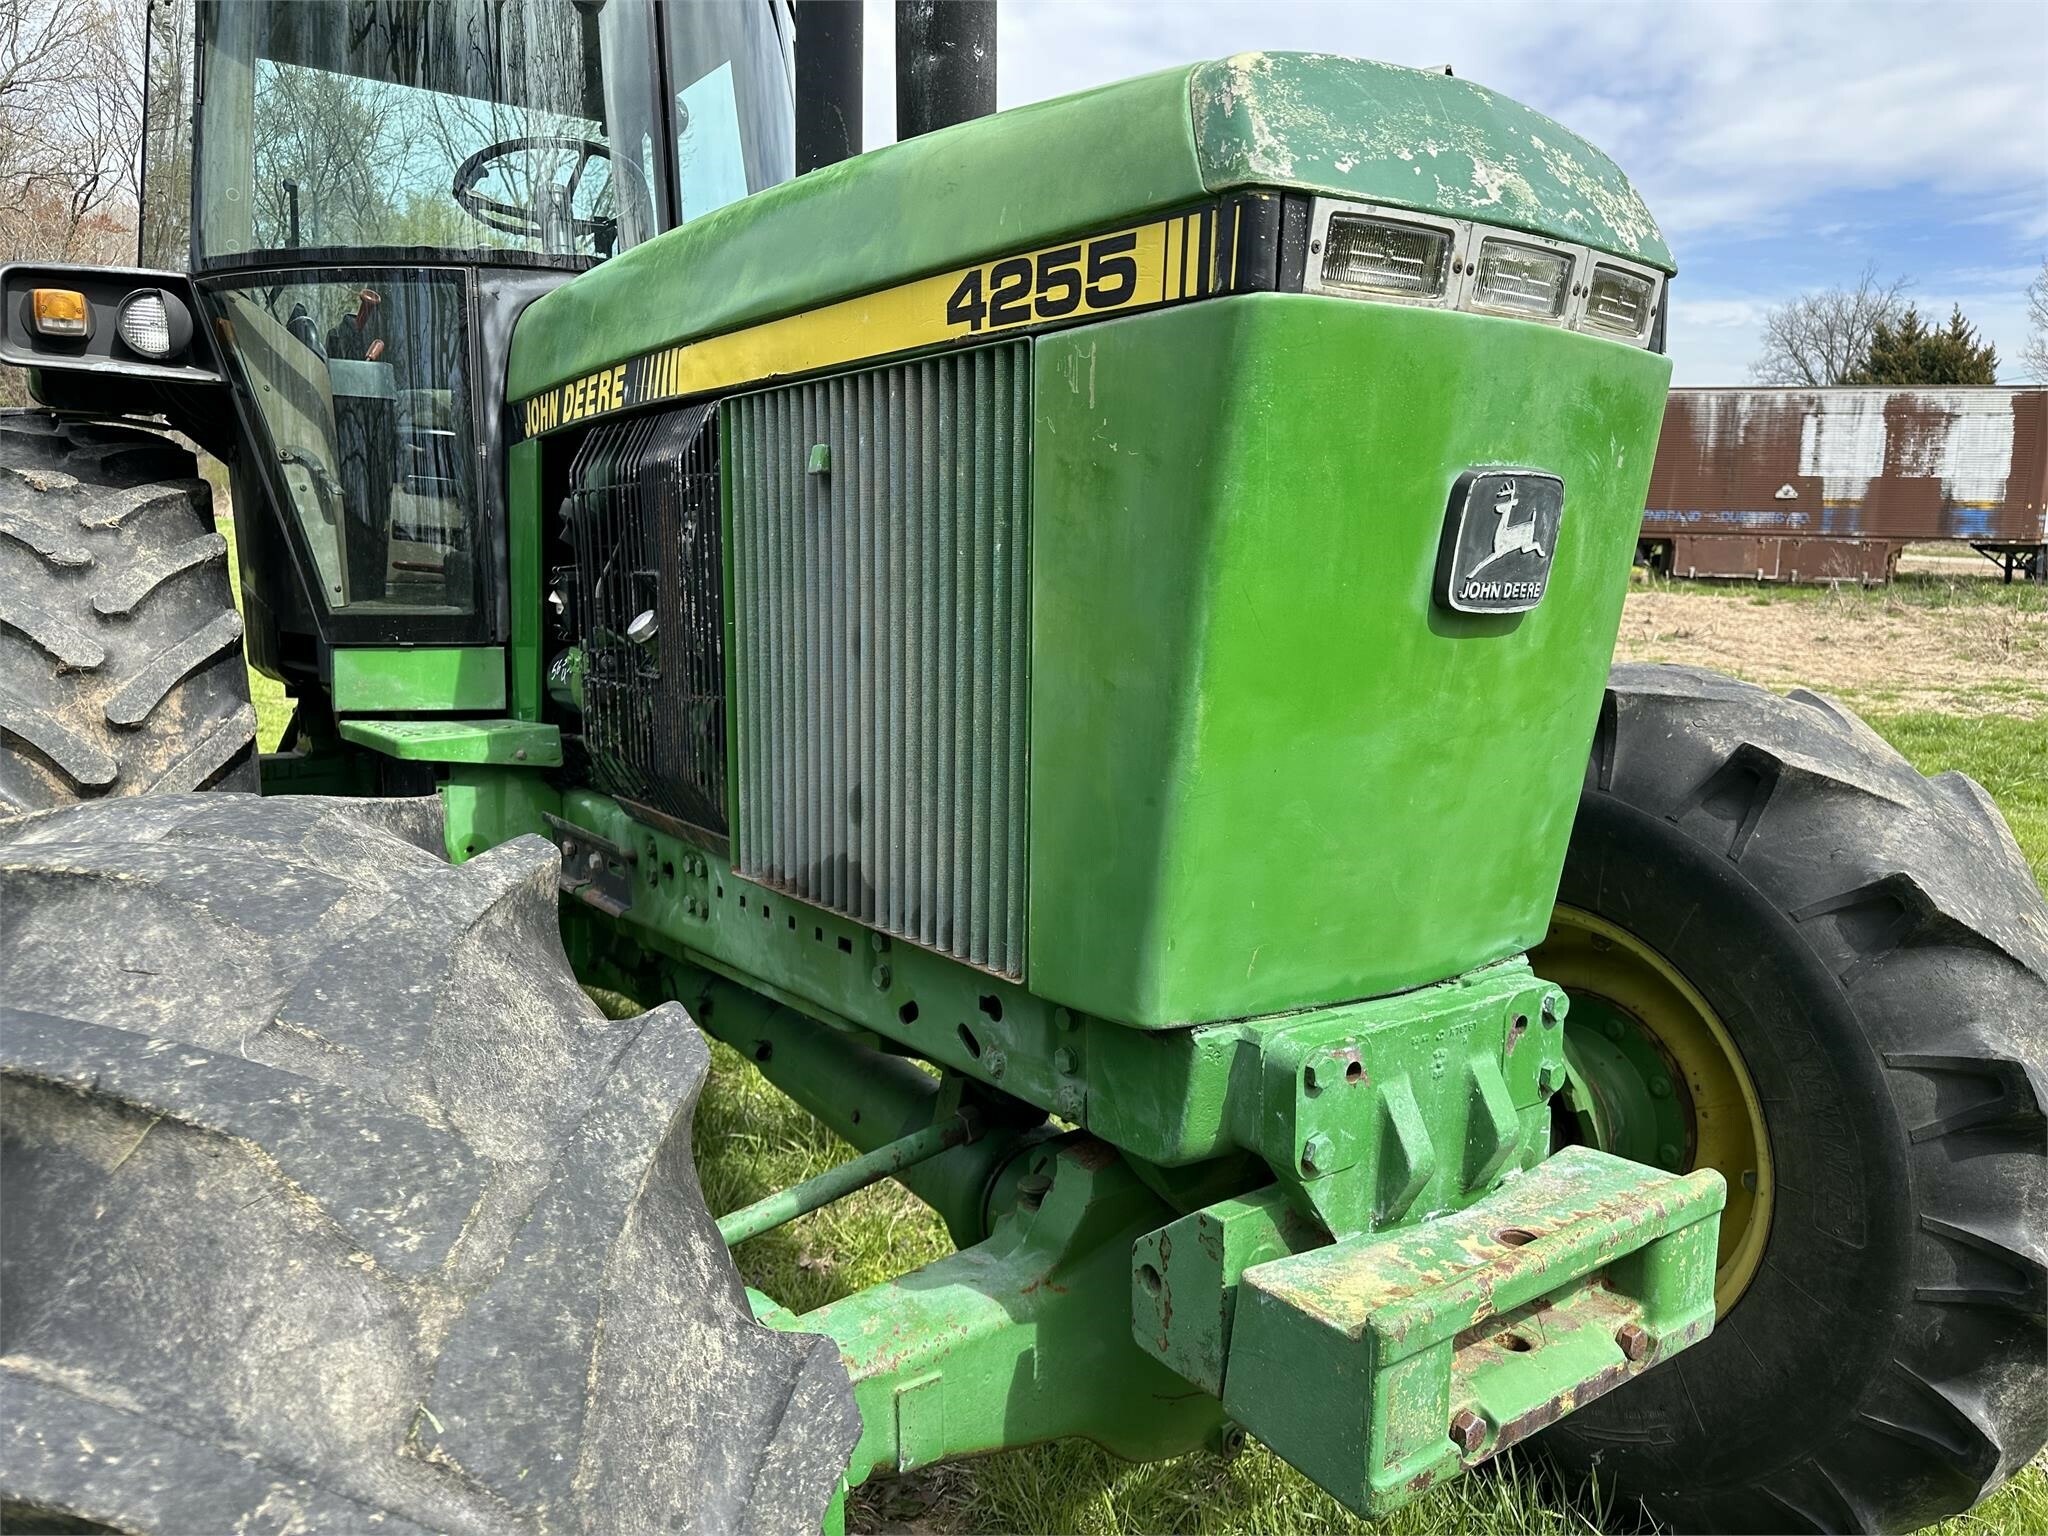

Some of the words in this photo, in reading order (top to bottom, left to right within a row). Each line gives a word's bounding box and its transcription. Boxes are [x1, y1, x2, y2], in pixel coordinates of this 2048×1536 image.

[947, 232, 1137, 331] 4255
[525, 389, 559, 438] JOHN
[562, 364, 626, 423] DEERE
[1459, 581, 1501, 599] JOHN
[1503, 581, 1541, 598] DEERE
